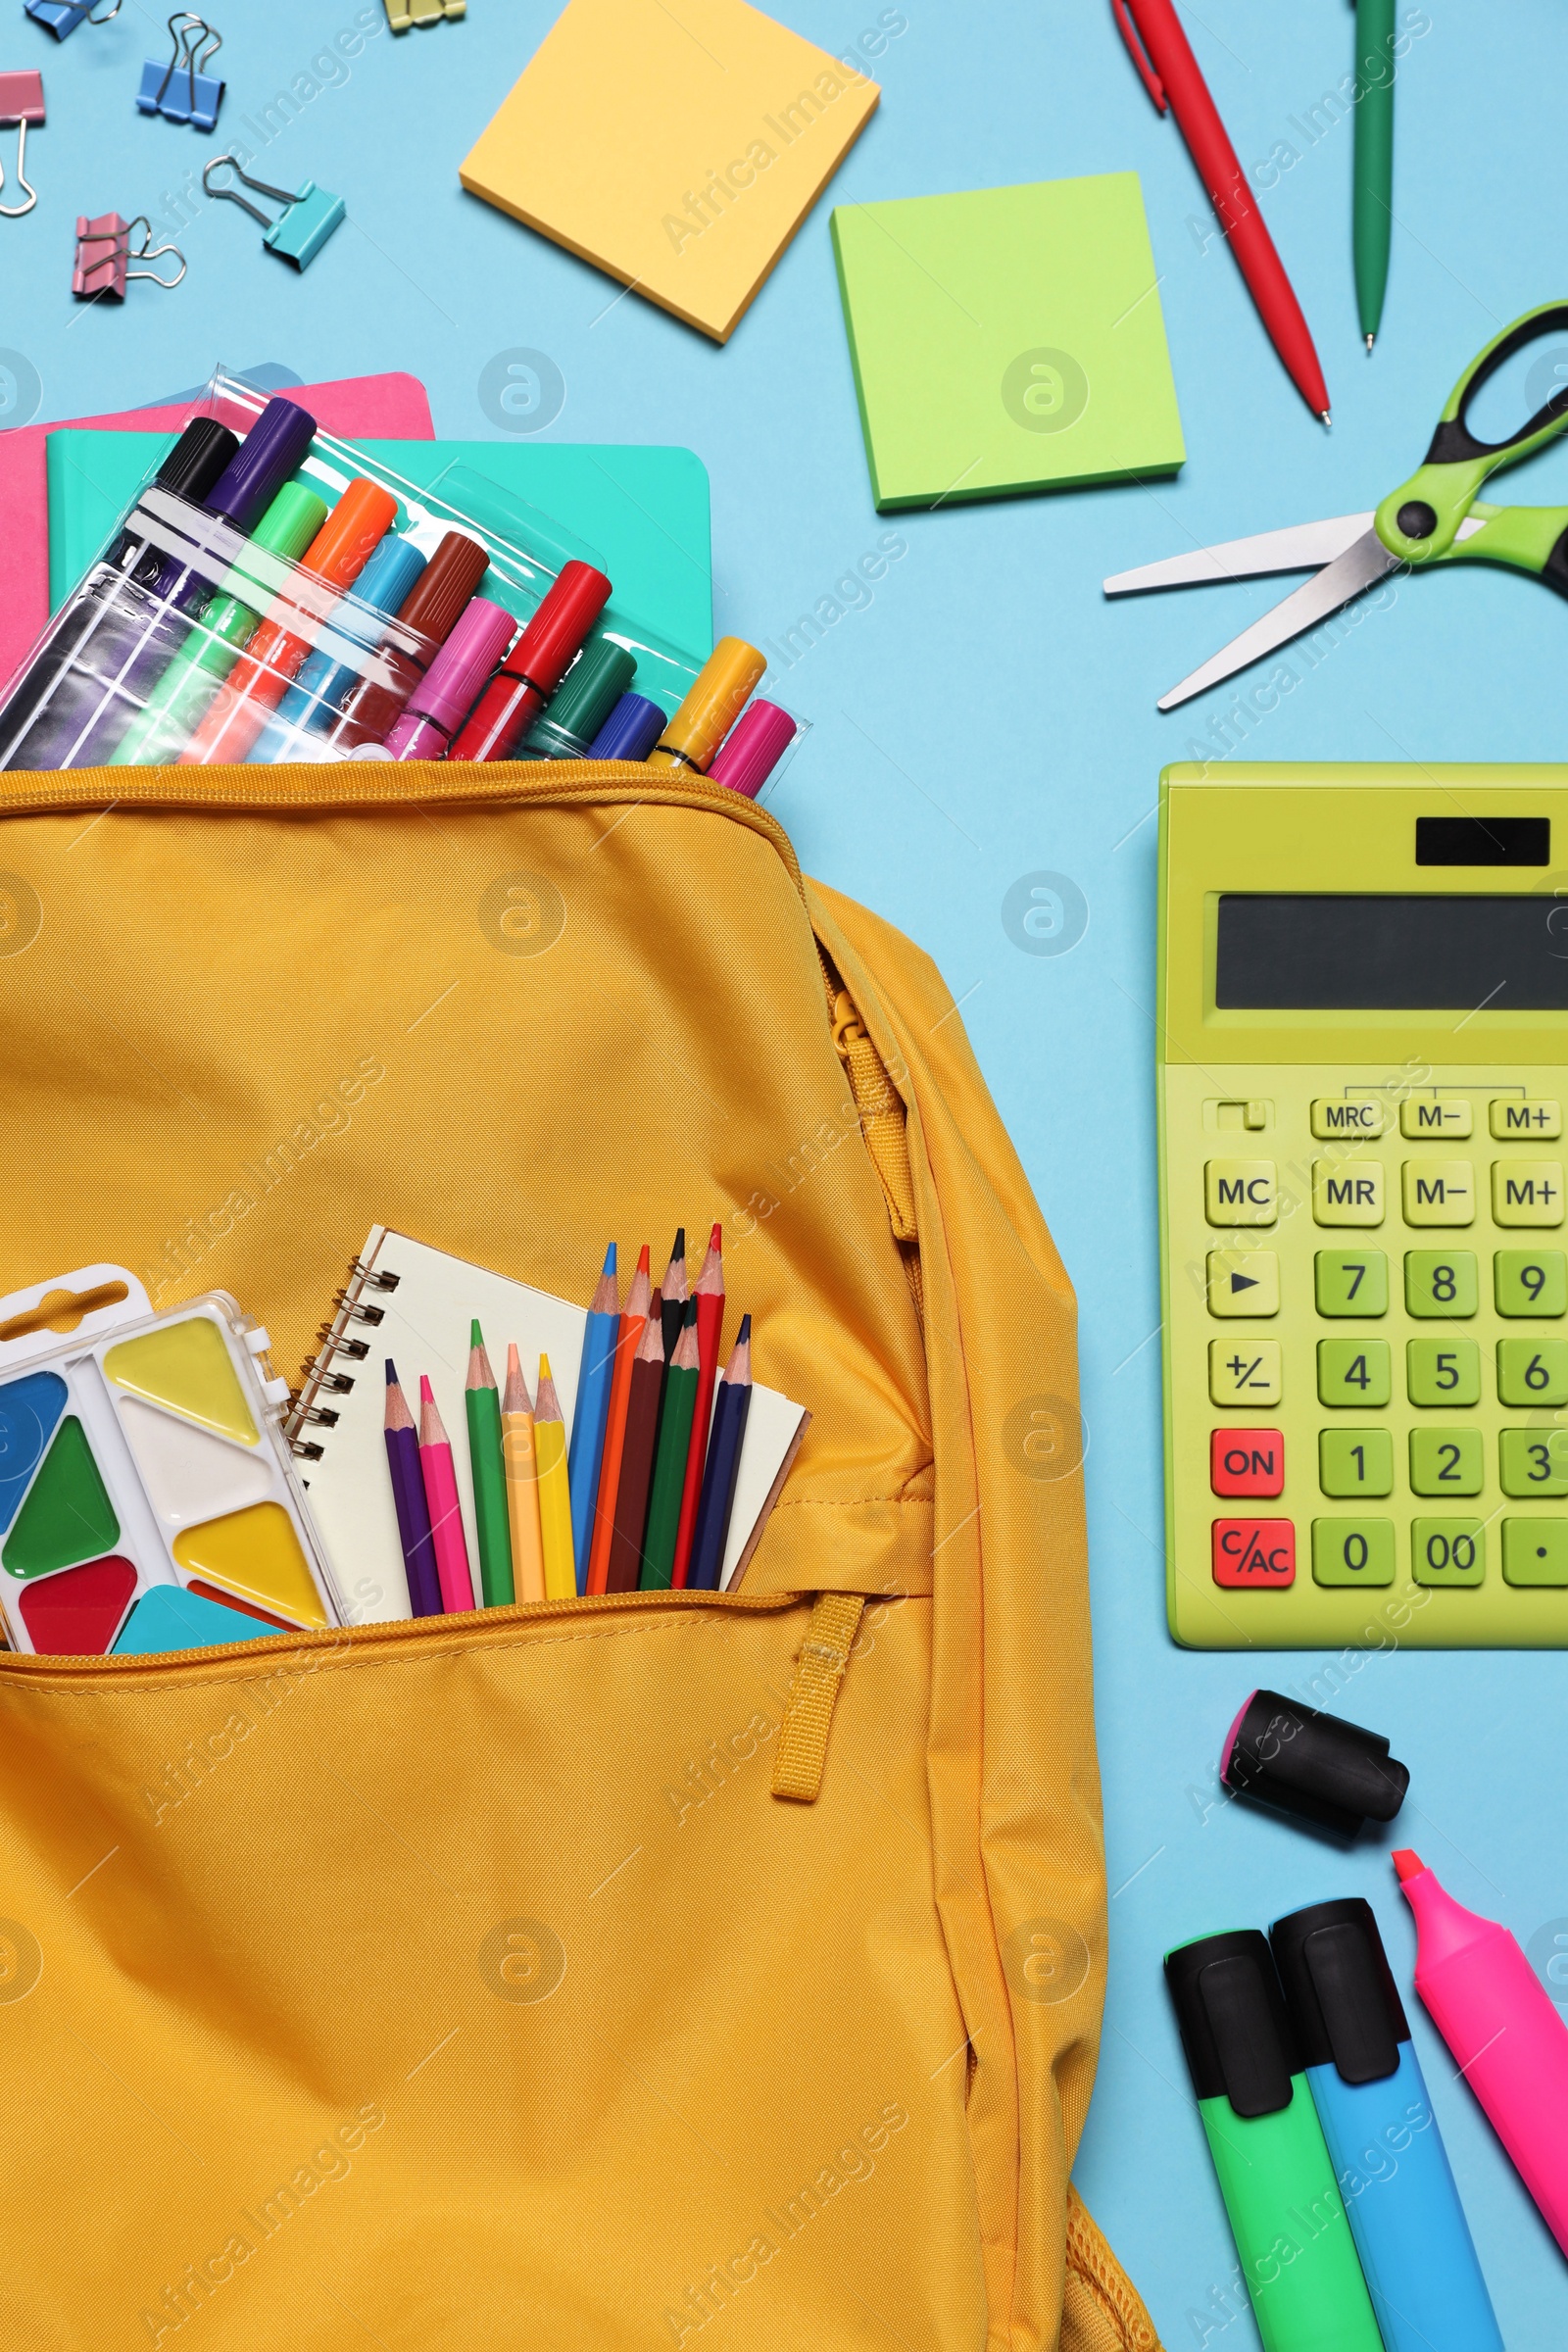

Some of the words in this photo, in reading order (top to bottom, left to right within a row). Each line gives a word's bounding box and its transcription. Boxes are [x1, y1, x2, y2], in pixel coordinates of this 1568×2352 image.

[1326, 1106, 1374, 1128] MRC
[1506, 1107, 1550, 1128] M+
[1218, 1178, 1270, 1204] MC
[1327, 1179, 1375, 1205] MR
[1506, 1179, 1556, 1205] M+
[1342, 1265, 1366, 1300] 7
[1432, 1265, 1456, 1302] 8
[1520, 1265, 1545, 1301] 9
[1344, 1354, 1371, 1391] 4
[1436, 1353, 1459, 1391] 5
[1524, 1354, 1549, 1391] 6
[1224, 1449, 1274, 1476] ON
[1349, 1446, 1364, 1481] 1
[1438, 1444, 1461, 1481] 2
[1527, 1444, 1551, 1482] 3
[1343, 1533, 1368, 1571] 0
[1426, 1534, 1476, 1570] 00
